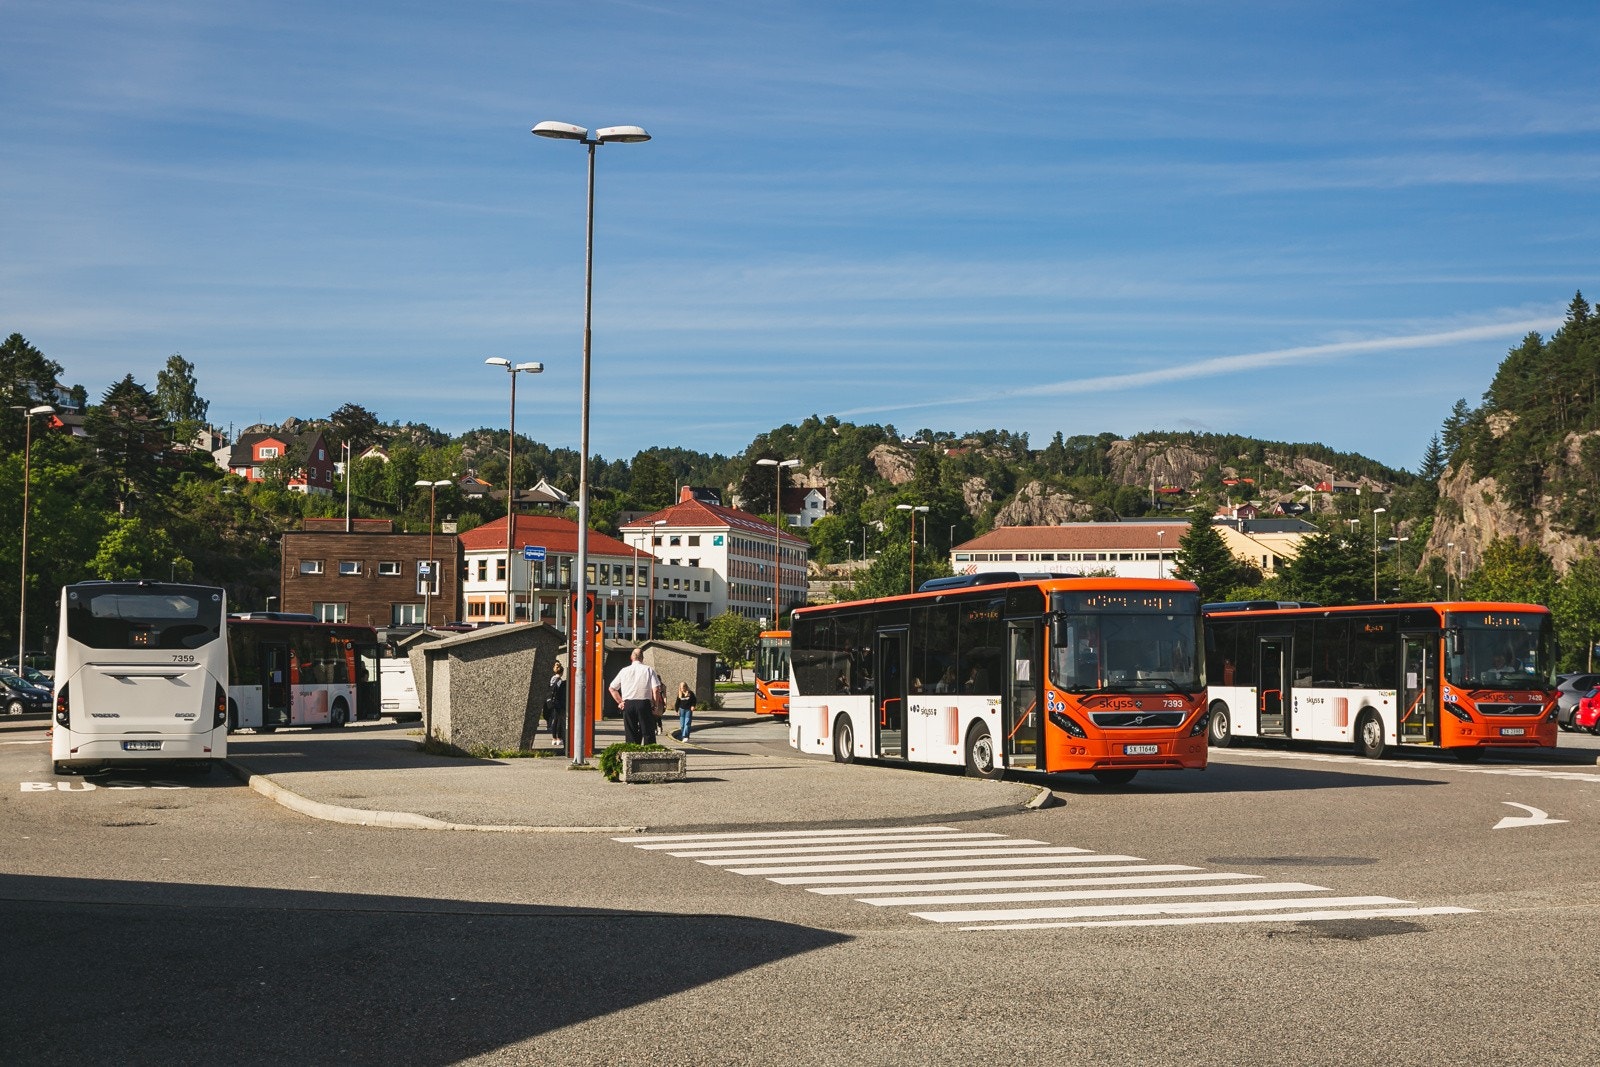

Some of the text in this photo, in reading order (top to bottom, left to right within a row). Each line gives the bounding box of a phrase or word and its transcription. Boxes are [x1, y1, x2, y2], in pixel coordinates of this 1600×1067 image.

[172, 654, 195, 662] 7359
[1099, 698, 1133, 710] skyss
[1162, 699, 1183, 708] 7393
[1139, 745, 1156, 753] 11646
